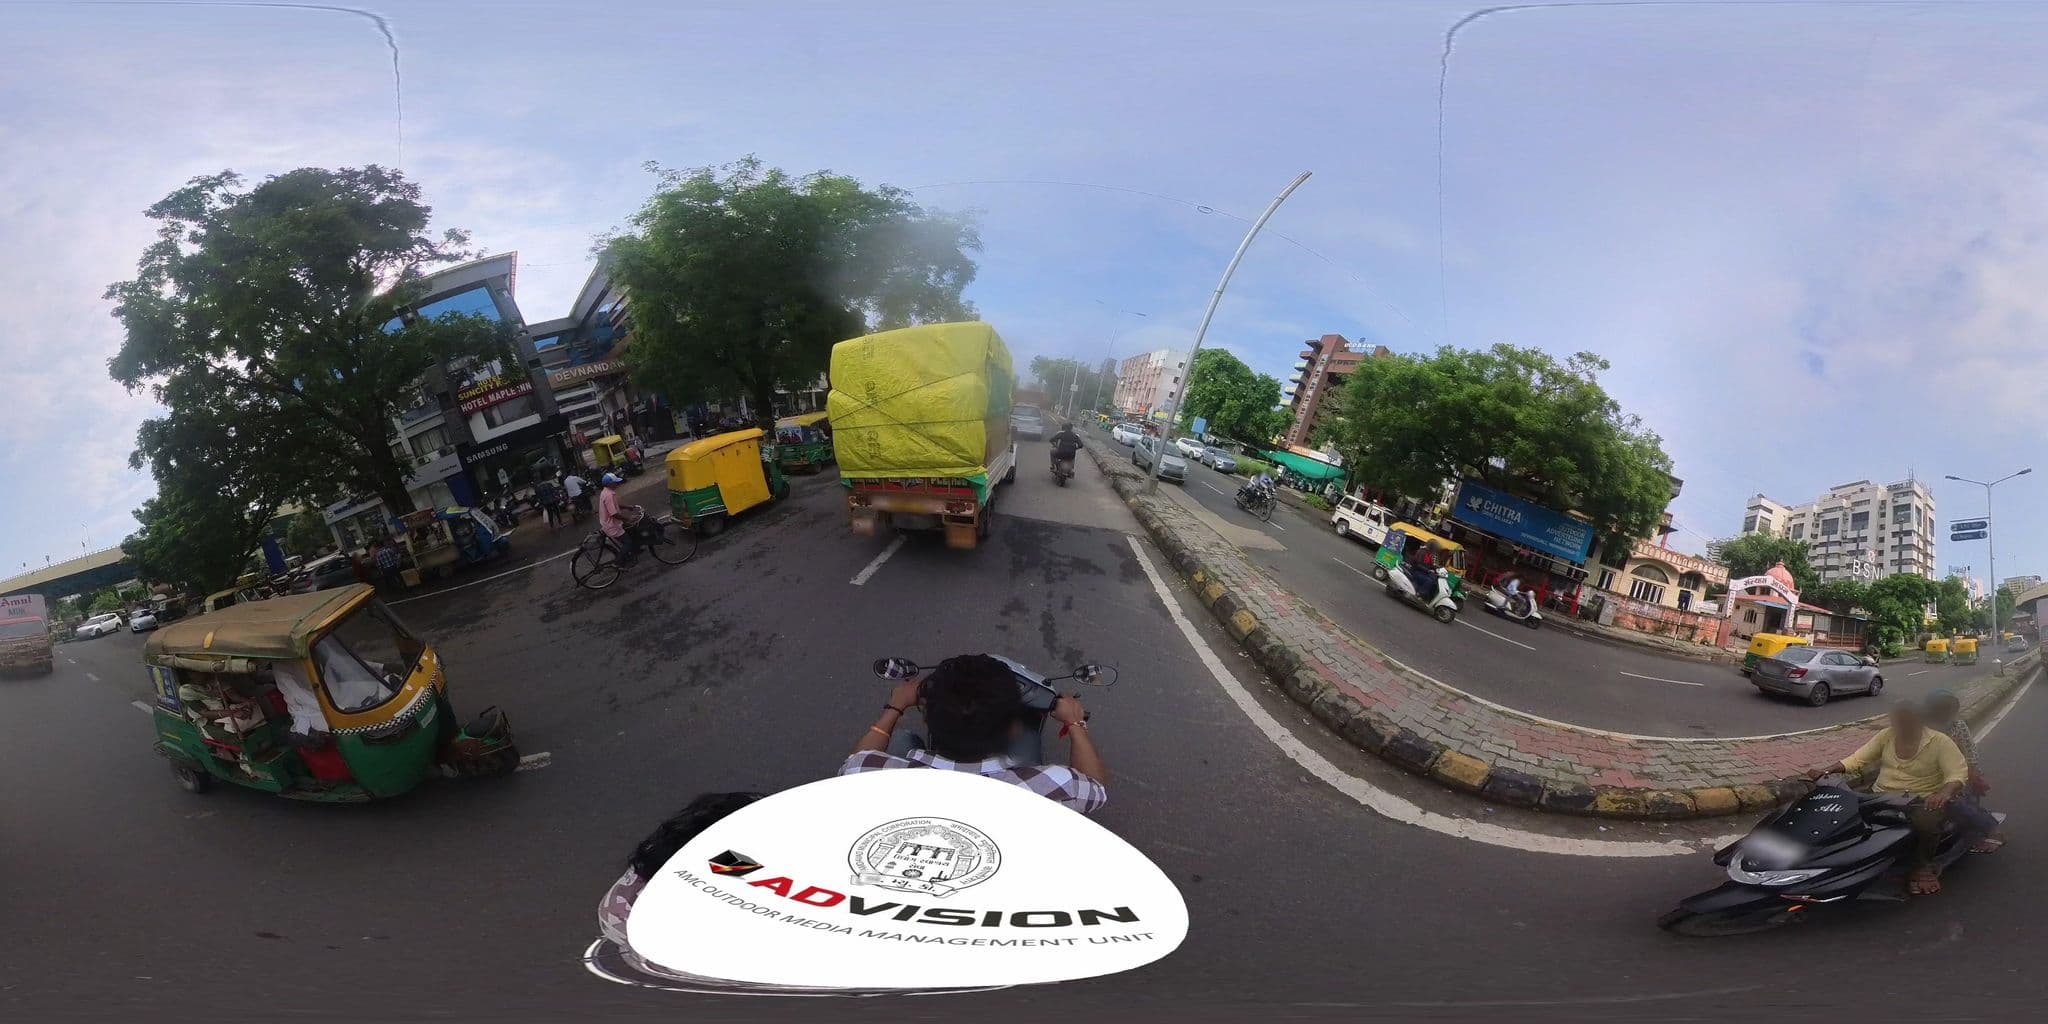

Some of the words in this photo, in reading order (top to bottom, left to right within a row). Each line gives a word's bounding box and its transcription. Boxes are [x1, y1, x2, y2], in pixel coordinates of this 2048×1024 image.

[458, 381, 494, 400] SUNCITY
[461, 397, 488, 412] HOTEL
[488, 388, 516, 402] MAPLE
[466, 442, 509, 463] SAMSUNG
[1483, 500, 1521, 523] CHITRA
[1, 595, 33, 607] Amul
[1814, 803, 1844, 812] Ali
